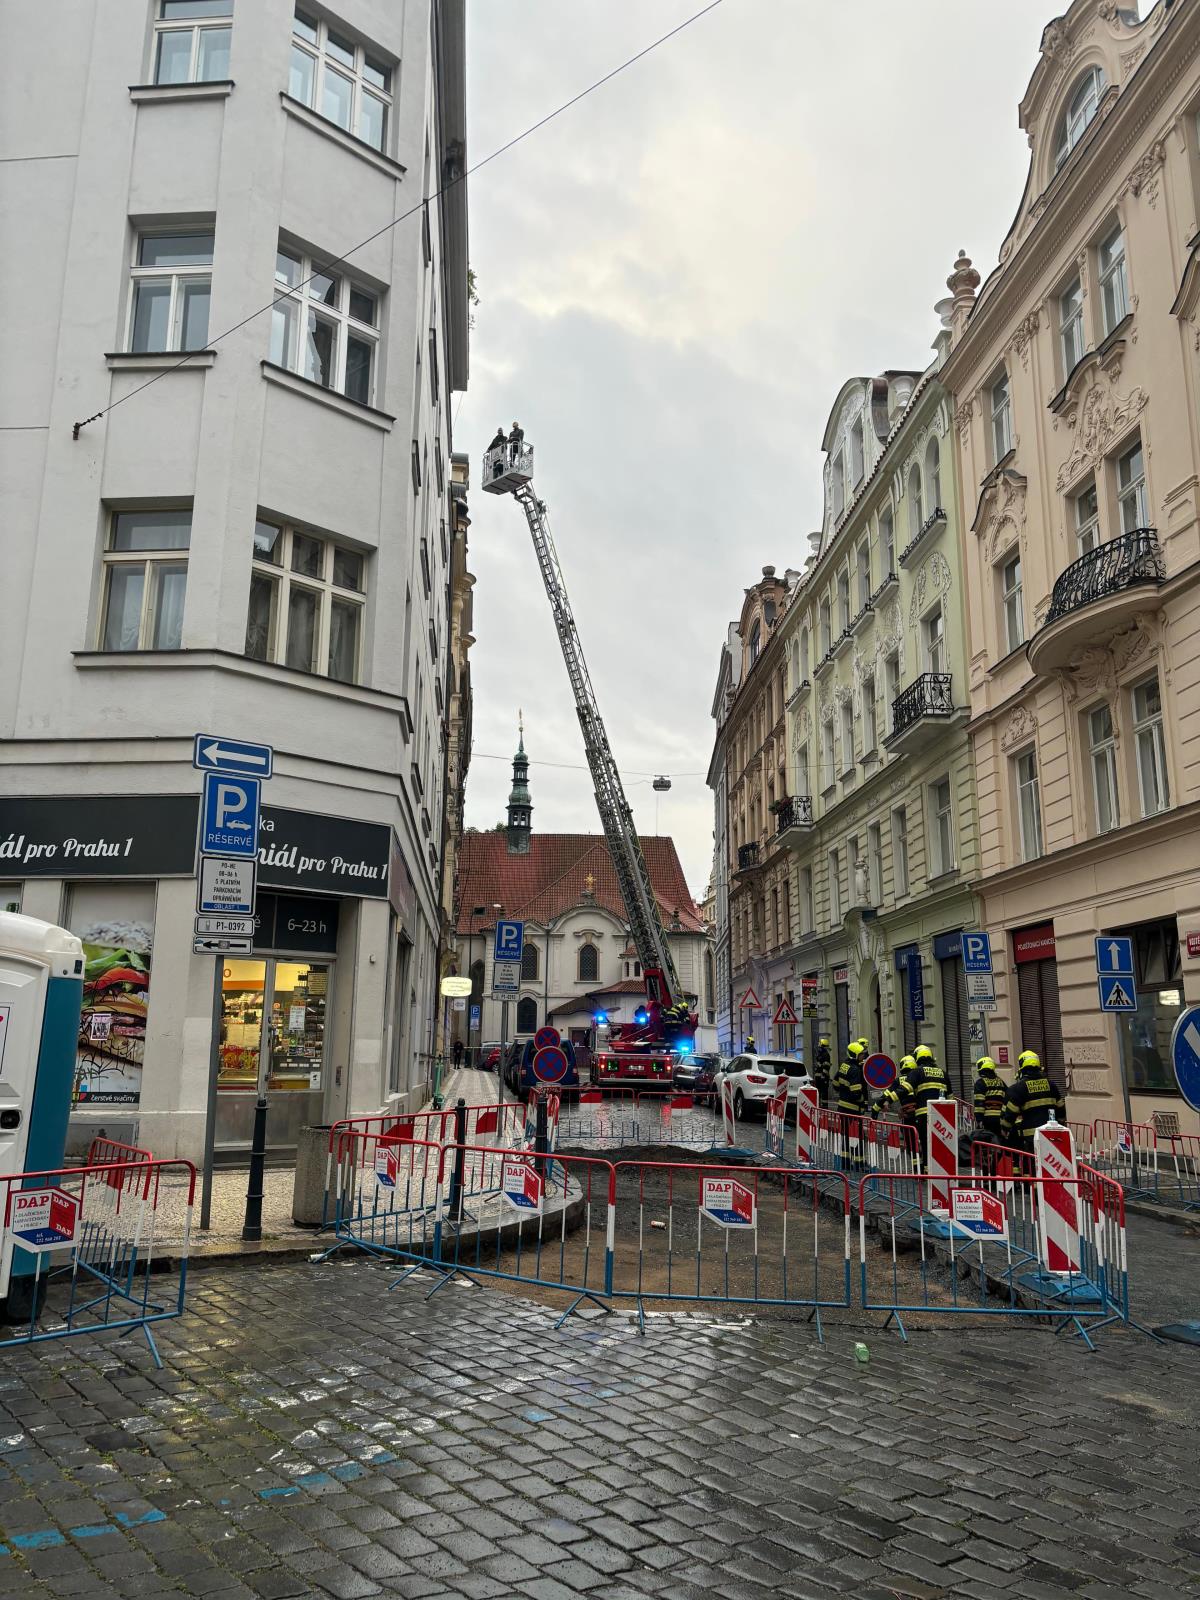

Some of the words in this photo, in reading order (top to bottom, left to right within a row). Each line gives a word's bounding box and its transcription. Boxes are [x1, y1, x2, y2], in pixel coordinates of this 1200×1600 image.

[216, 783, 247, 828] P
[208, 832, 252, 847] RÉSERVÉ
[23, 843, 58, 864] pro
[63, 838, 120, 857] Prahu
[124, 837, 133, 857] 1
[297, 856, 327, 874] pro
[331, 856, 377, 879] Prahu
[381, 863, 388, 880] 1
[213, 902, 235, 910] OBLAST
[216, 921, 245, 931] P1-0392
[320, 920, 327, 933] h
[501, 925, 518, 948] P
[967, 937, 984, 960] P
[933, 1120, 953, 1140] DAP
[507, 1167, 524, 1177] DAP
[1044, 1152, 1071, 1178] DAP
[707, 1182, 732, 1193] DAP
[16, 1195, 50, 1210] DAP
[53, 1195, 70, 1208] DAP
[956, 1194, 981, 1203] DAP
[55, 1223, 72, 1236] DAP
